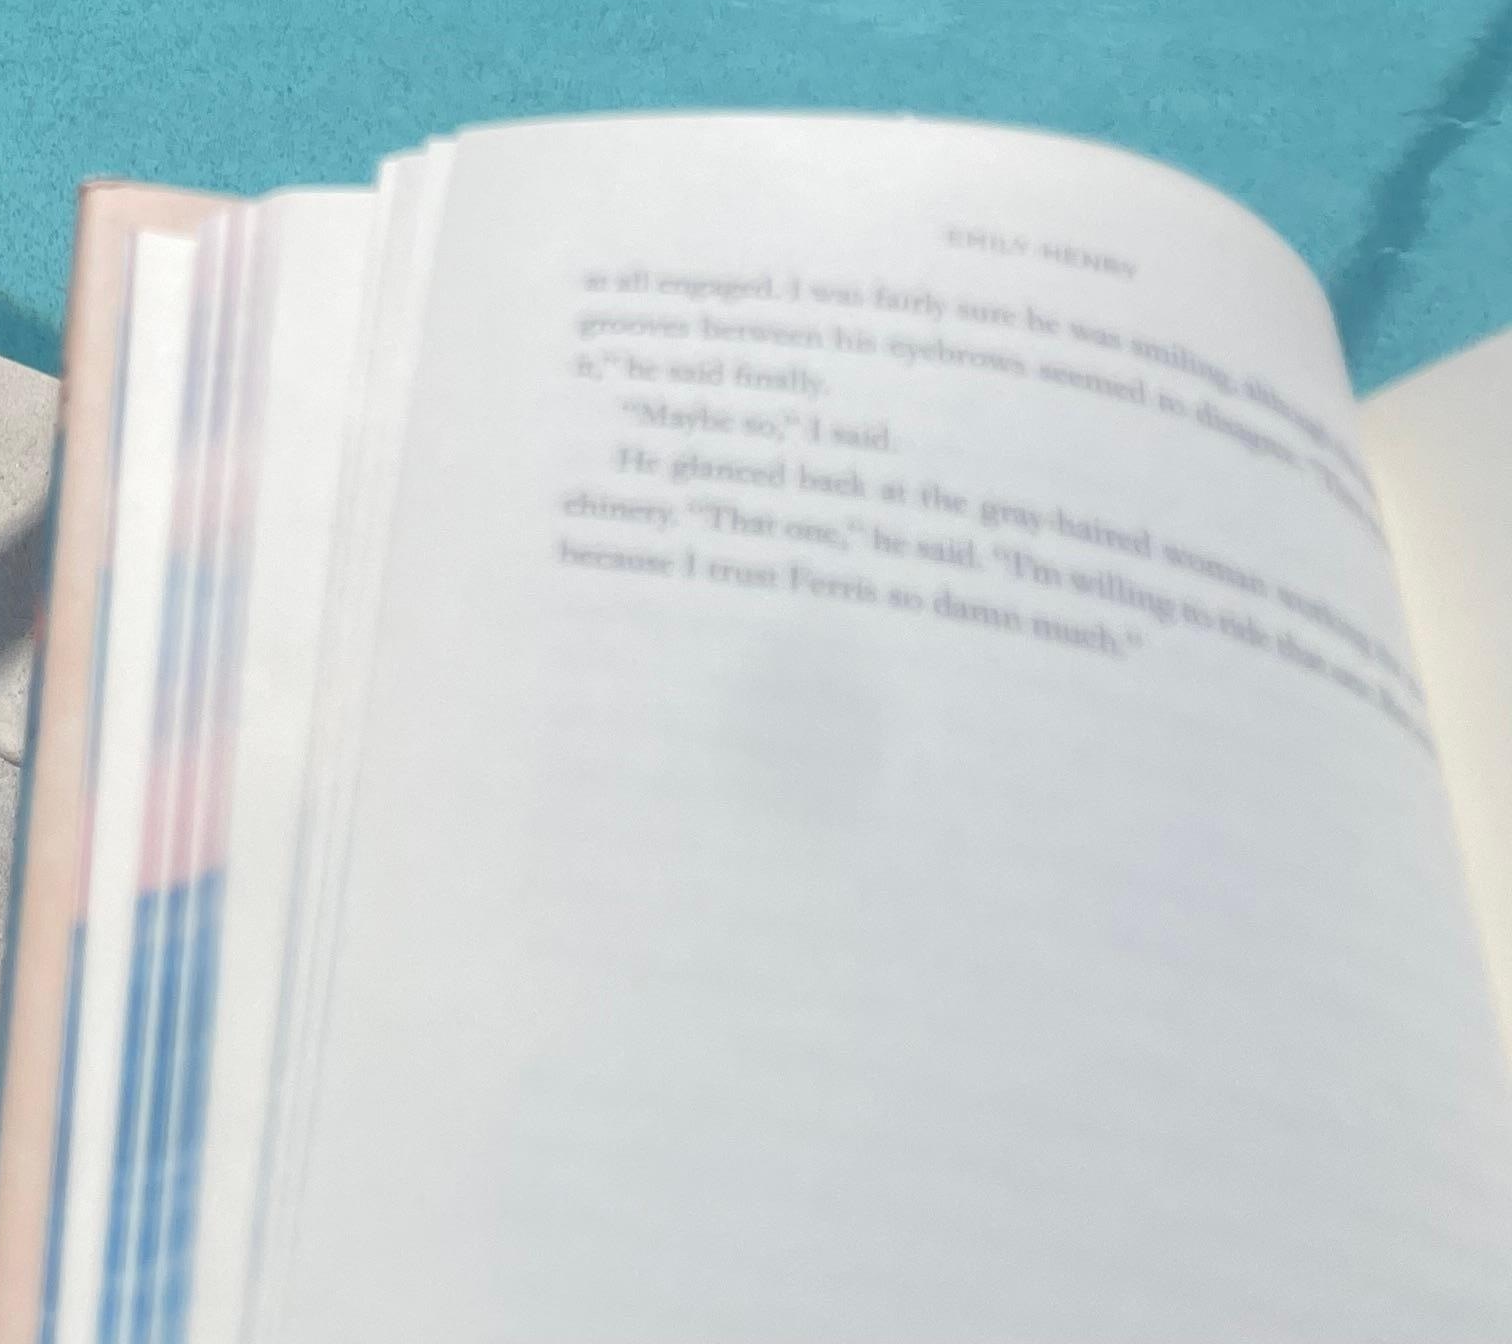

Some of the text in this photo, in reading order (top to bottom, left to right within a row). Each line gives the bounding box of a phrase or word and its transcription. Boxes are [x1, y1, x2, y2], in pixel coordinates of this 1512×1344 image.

[947, 228, 1137, 279] EMILY HENRY
[583, 269, 608, 294] at
[614, 267, 650, 294] all
[657, 272, 779, 304] engaged.
[810, 283, 865, 306] was
[874, 281, 947, 322] fairly
[958, 302, 1018, 325] sure
[1026, 305, 1060, 334] he
[1070, 321, 1122, 349] was
[578, 315, 689, 341] grooves
[700, 313, 825, 350] between
[834, 323, 877, 354] his
[886, 336, 1028, 378] eyebrows
[1039, 361, 1146, 405] seemed
[1157, 390, 1189, 416] to
[627, 354, 660, 382] he
[668, 359, 725, 388] said
[735, 362, 831, 401] finally.
[830, 422, 898, 455] said.
[562, 490, 678, 532] chinery.
[873, 523, 905, 554] he
[916, 535, 984, 570] said.
[1069, 571, 1176, 626] willing
[1182, 599, 1216, 629] to
[617, 446, 660, 475] He
[670, 454, 786, 490] glanced
[798, 462, 866, 498] back
[879, 481, 905, 502] at
[920, 481, 968, 513] the
[981, 500, 1152, 559] gray-haired
[1161, 543, 1269, 599] woman
[558, 535, 675, 575] because
[709, 561, 778, 589] trust
[789, 563, 879, 602] Ferris
[887, 588, 925, 611] so
[932, 589, 1021, 631] damn
